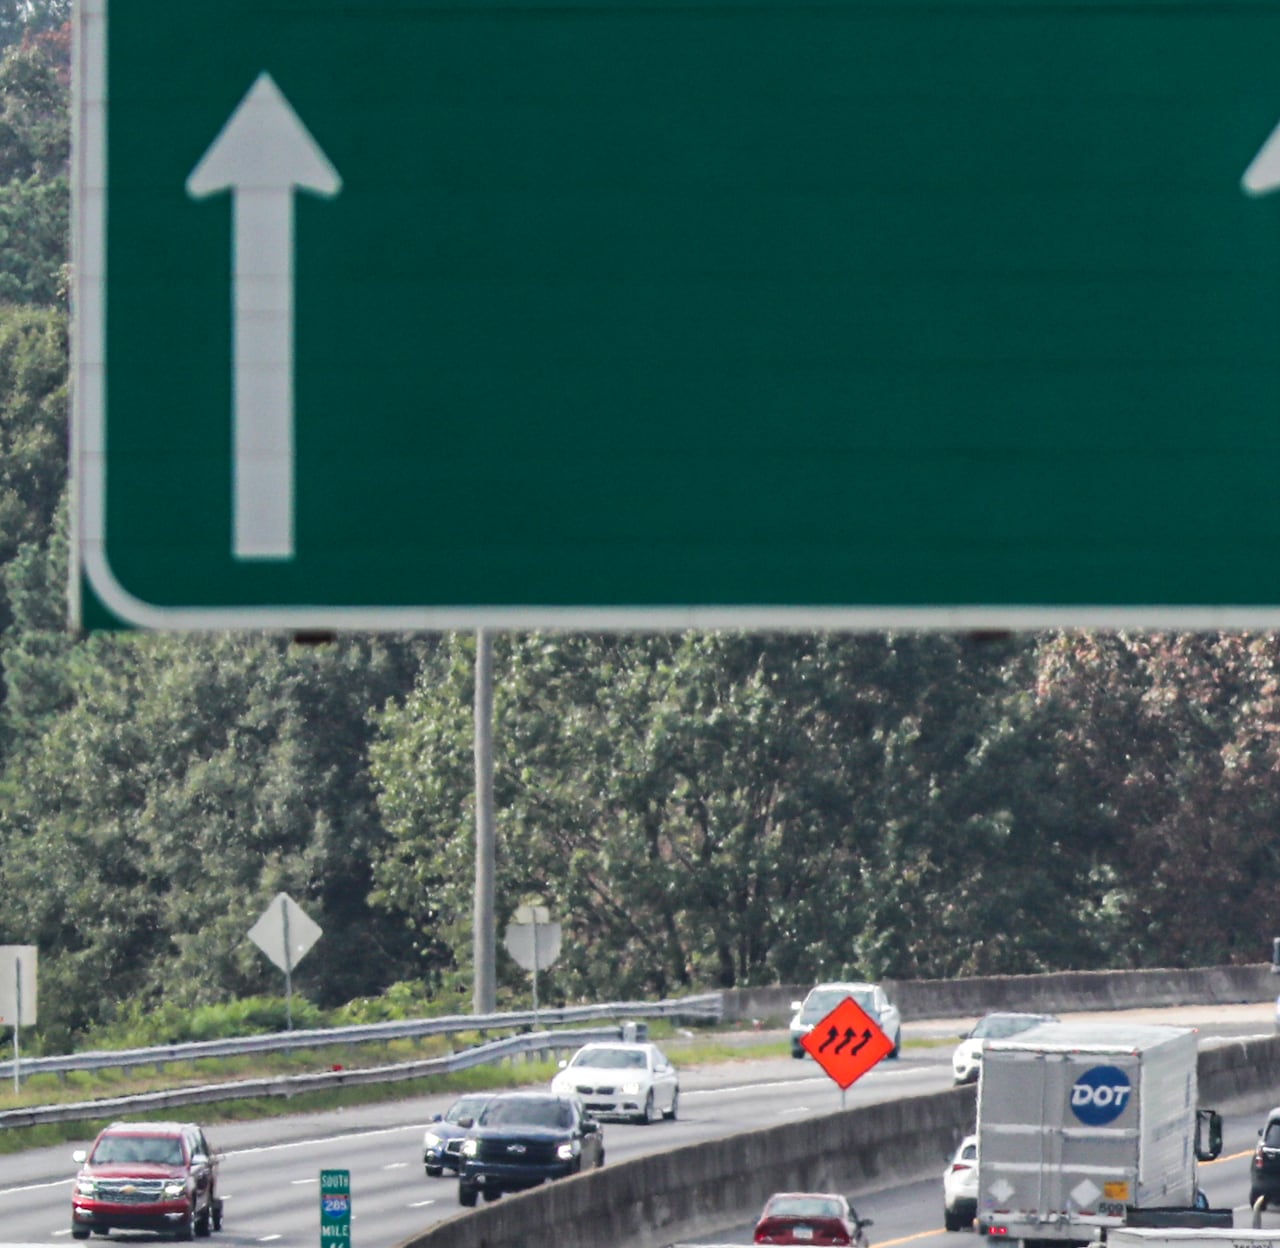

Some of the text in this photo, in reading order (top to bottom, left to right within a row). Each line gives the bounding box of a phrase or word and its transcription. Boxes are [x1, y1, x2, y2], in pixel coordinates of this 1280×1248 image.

[1071, 1084, 1131, 1106] DOT
[322, 1175, 349, 1188] SOUTH
[325, 1200, 347, 1212] 285
[322, 1225, 349, 1237] MILE
